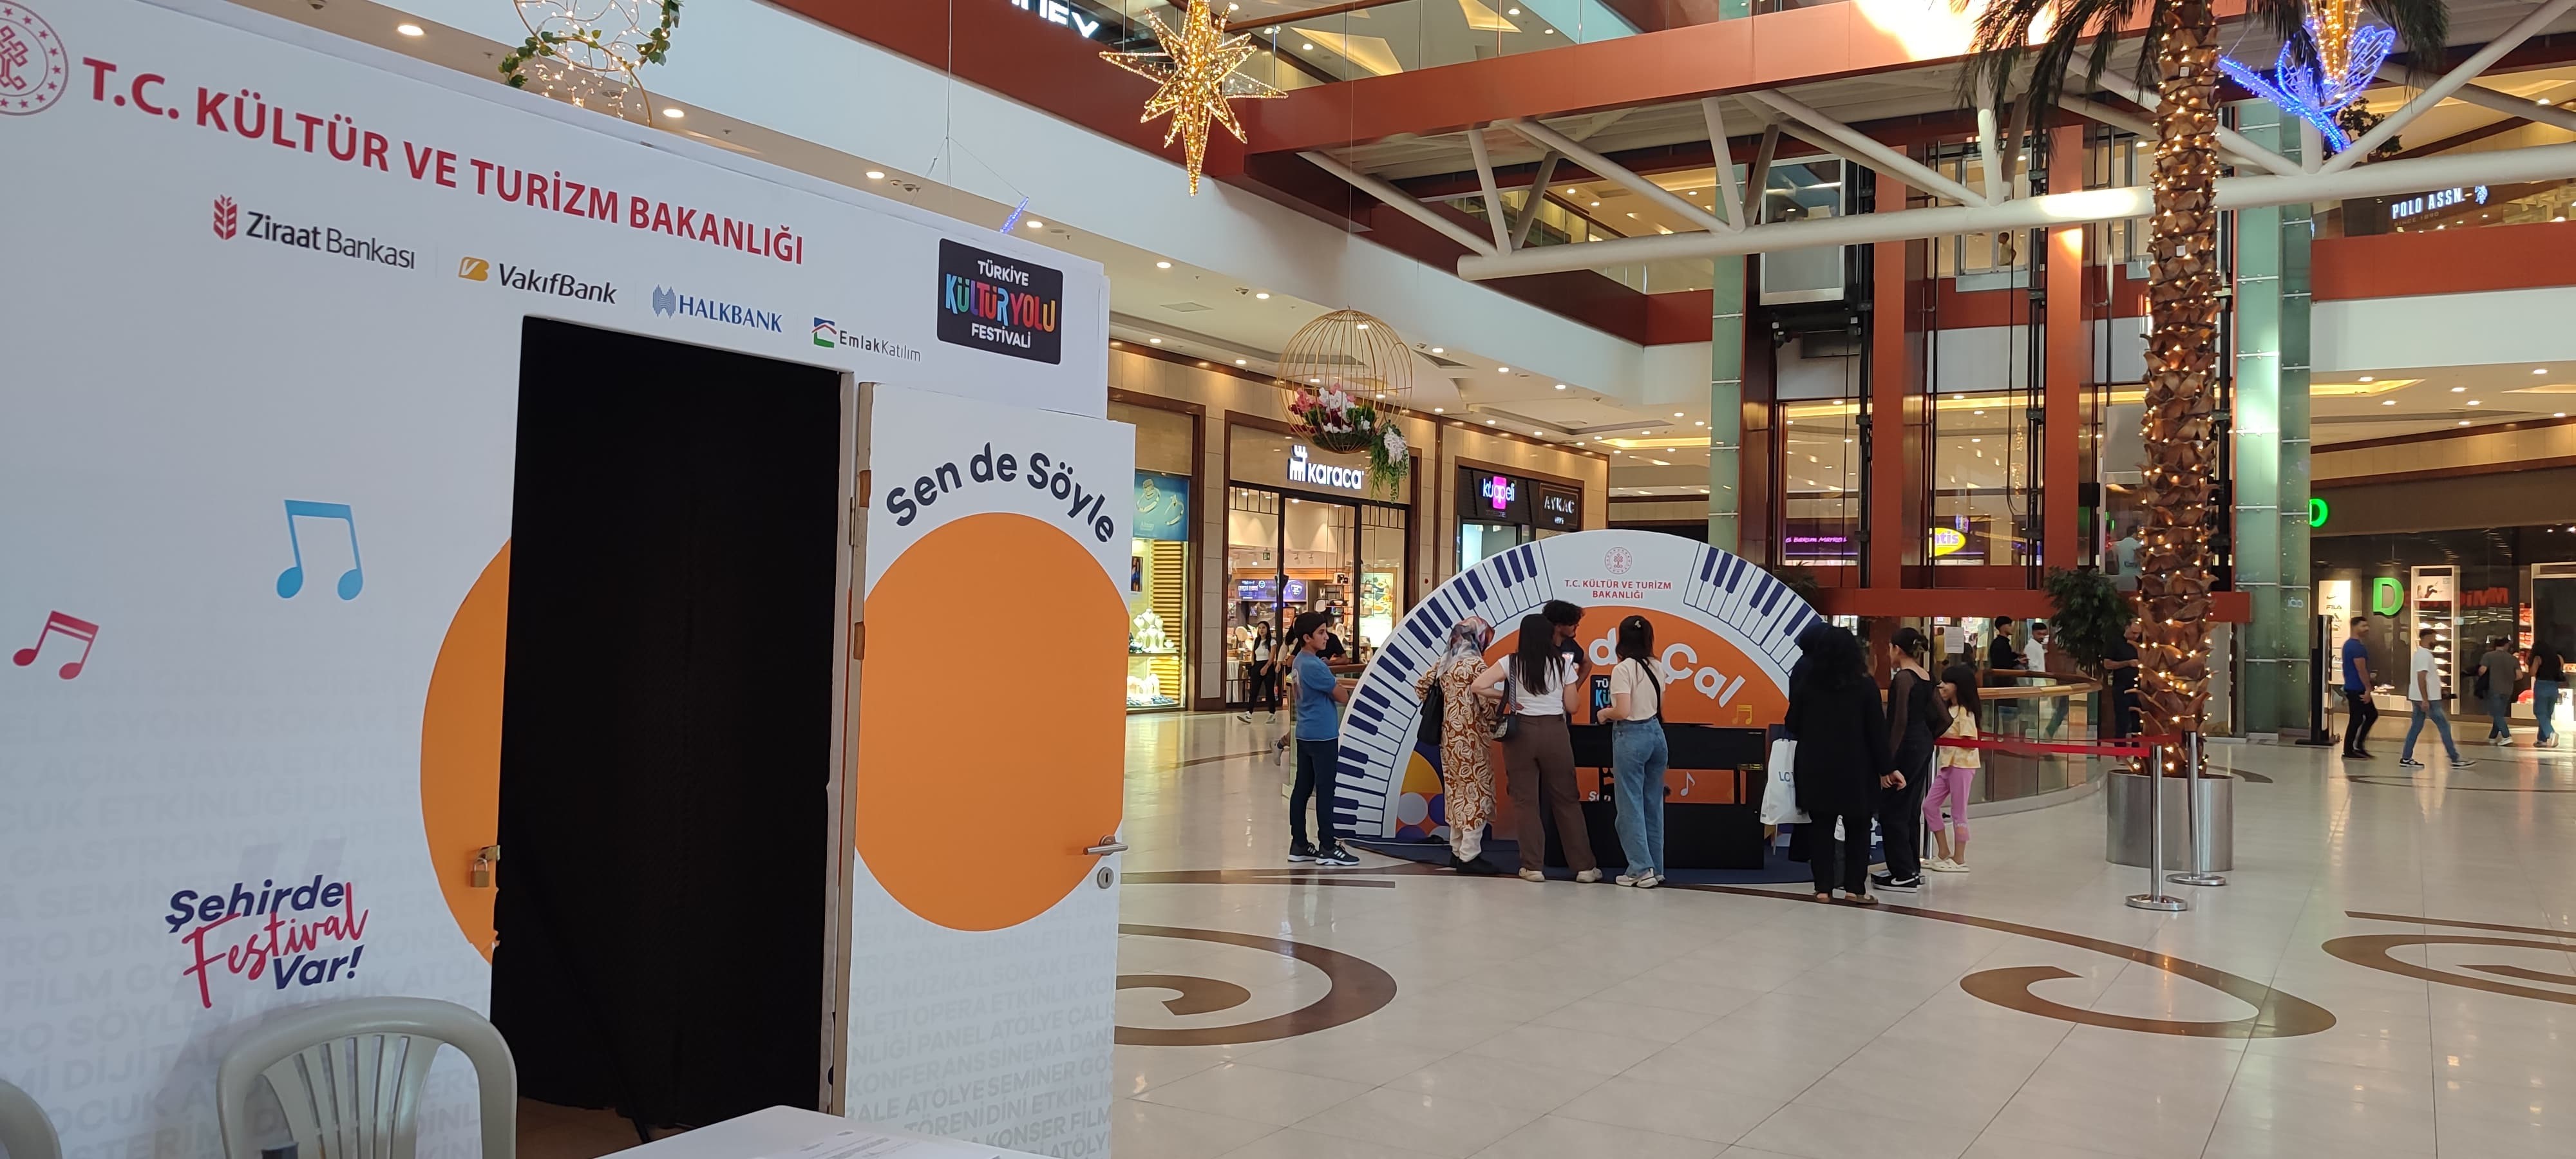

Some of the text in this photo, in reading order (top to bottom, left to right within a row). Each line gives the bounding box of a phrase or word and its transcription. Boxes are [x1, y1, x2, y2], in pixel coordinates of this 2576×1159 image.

[82, 57, 803, 265] T.C. KÜLTÜR VE TURİZM BAKANLIĞI
[2392, 187, 2465, 220] POLO ASSN.
[246, 211, 415, 270] Ziraat Bankası
[499, 263, 618, 305] VakıfBank
[977, 259, 1030, 287] TÜRKİYE
[678, 294, 782, 334] HALKBANK
[945, 273, 1056, 333] KÜLTÜR YOLU
[971, 323, 1032, 349] FESTİVALİ
[886, 440, 1116, 544] Sen de Söyle
[1307, 462, 1363, 489] karaca
[1582, 579, 1619, 589] KÜLTÜR
[1636, 580, 1672, 590] TURİZM
[1592, 590, 1643, 599] BAKANLIĞI
[1660, 643, 1747, 708] Çal
[165, 874, 344, 934] Şehirde
[182, 882, 369, 1008] Festival
[273, 944, 365, 991] Var!
